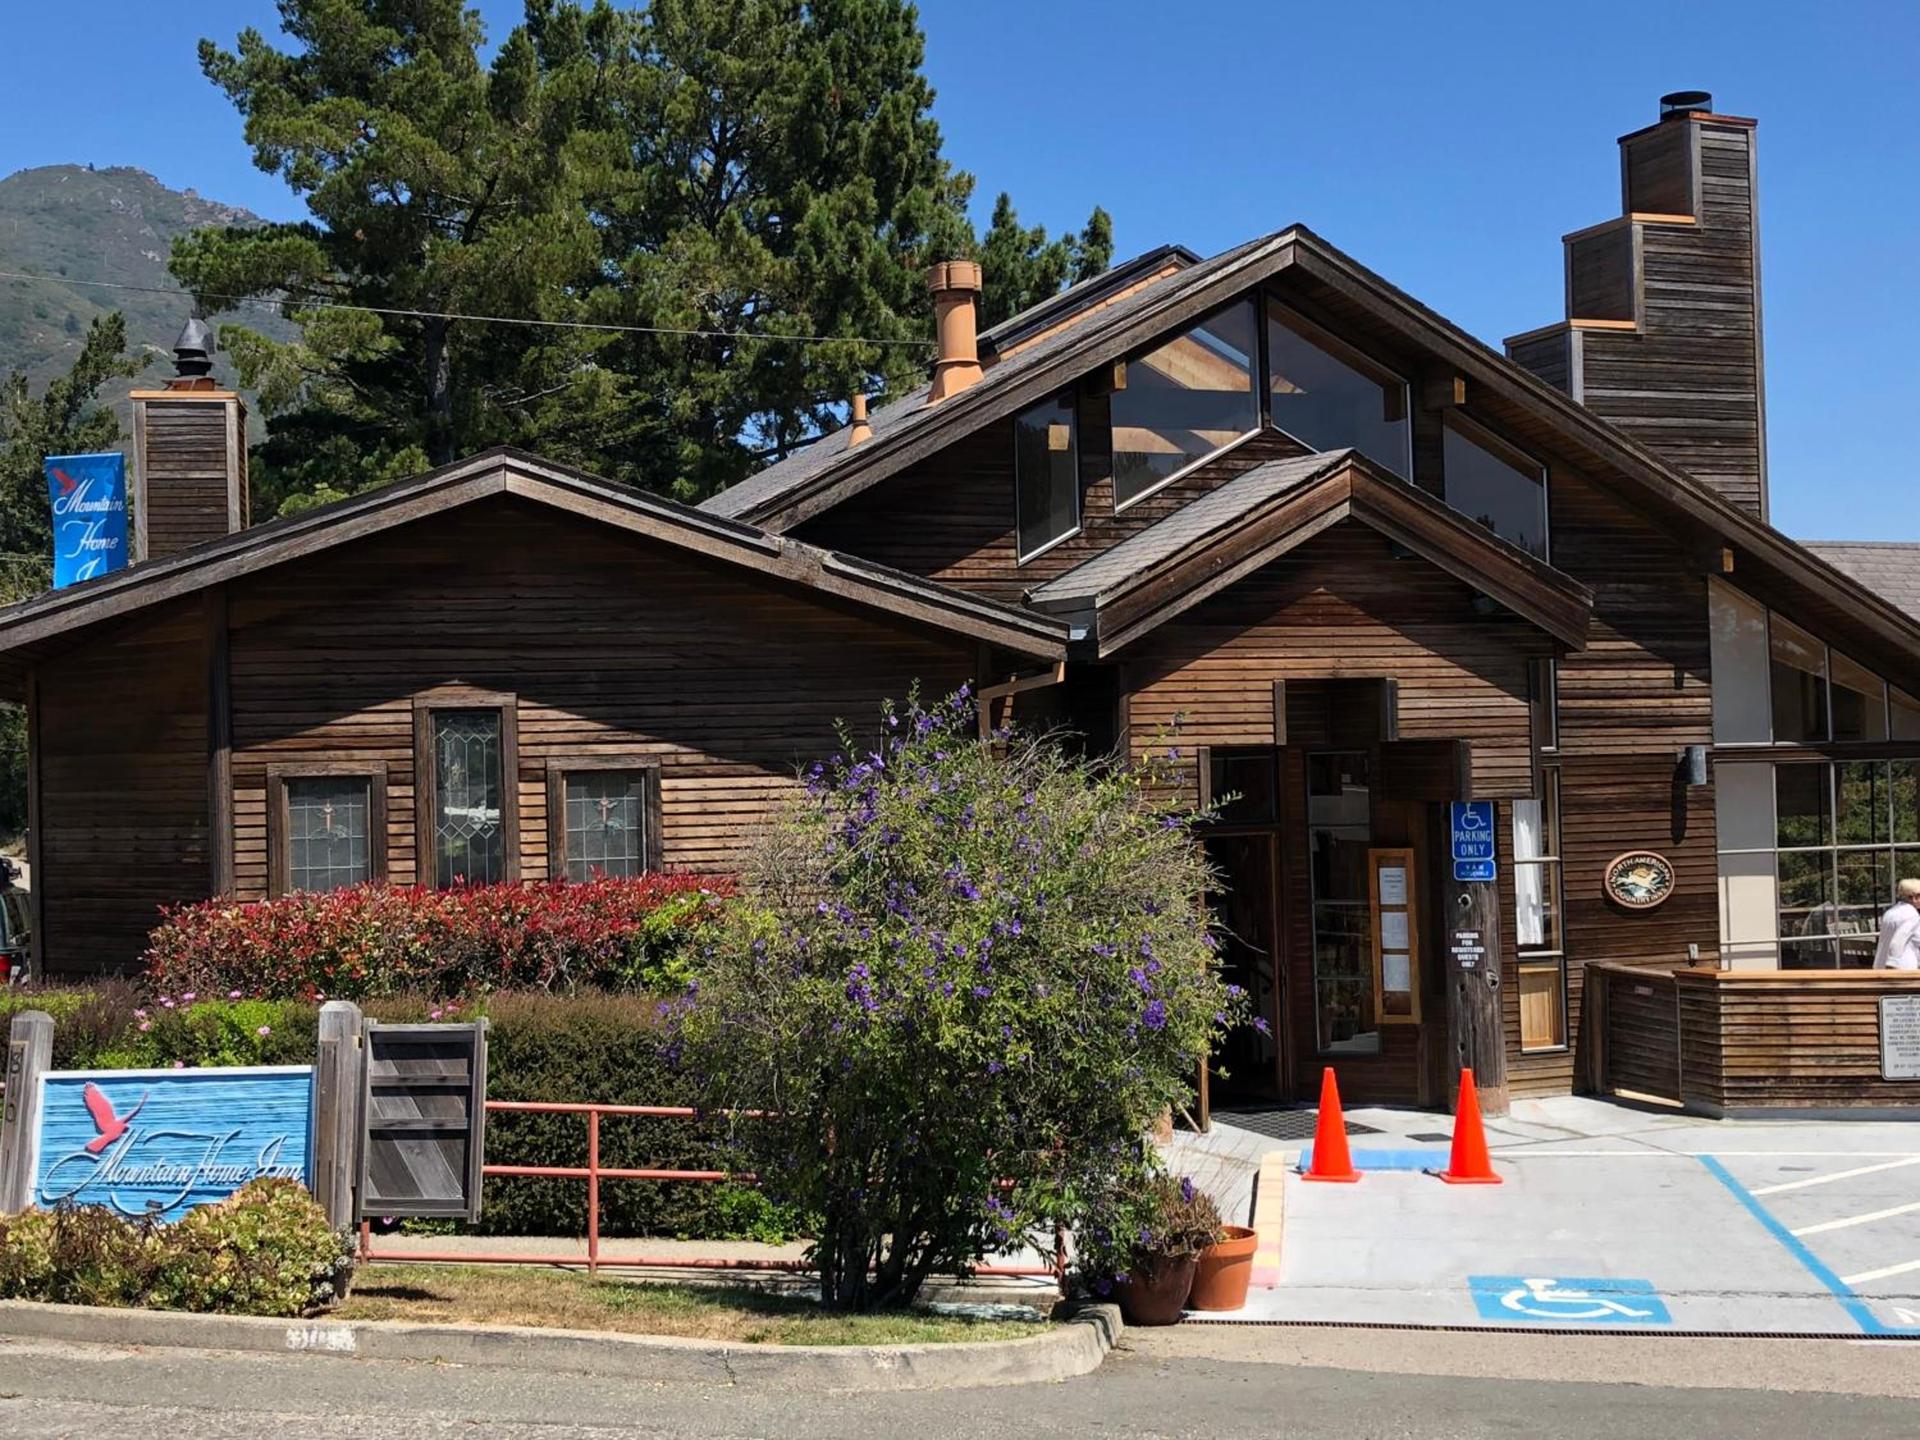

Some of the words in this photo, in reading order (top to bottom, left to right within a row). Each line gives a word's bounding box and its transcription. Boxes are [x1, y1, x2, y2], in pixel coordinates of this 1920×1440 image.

[53, 478, 124, 515] Mountain
[62, 518, 119, 558] Home
[1454, 830, 1491, 842] PARKING
[1460, 844, 1485, 856] ONLY
[41, 1128, 193, 1201] Mountain
[253, 1133, 304, 1181] Inn
